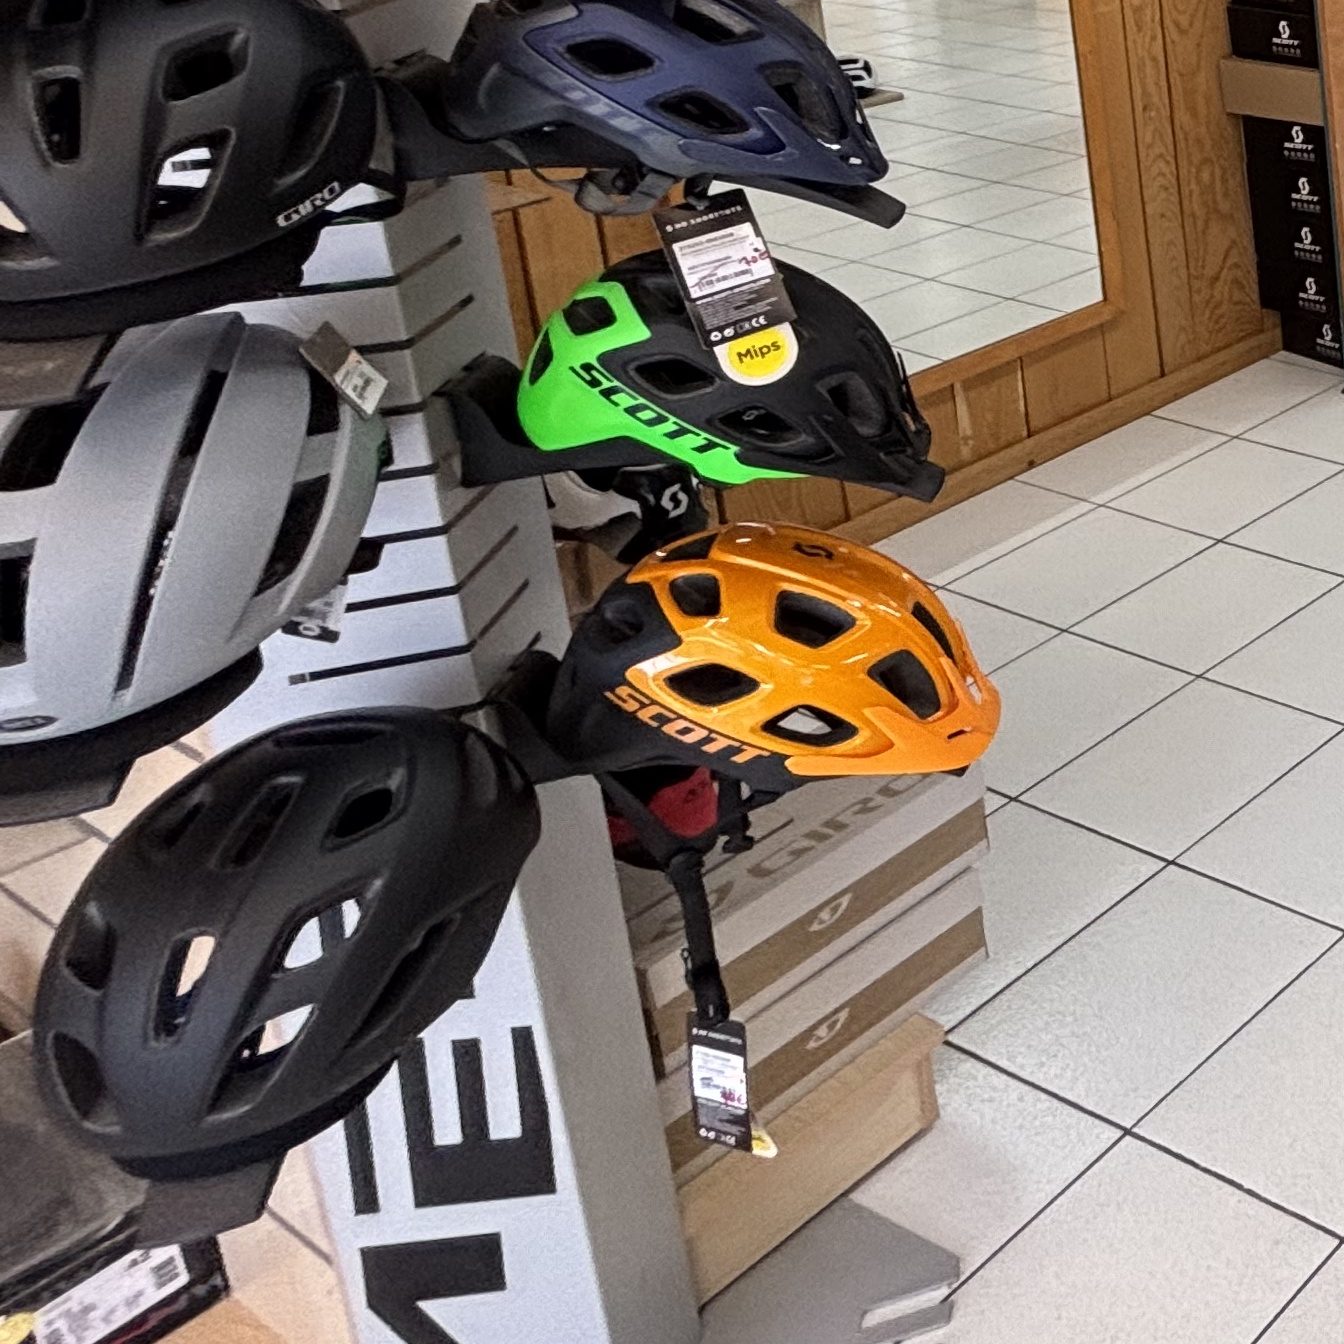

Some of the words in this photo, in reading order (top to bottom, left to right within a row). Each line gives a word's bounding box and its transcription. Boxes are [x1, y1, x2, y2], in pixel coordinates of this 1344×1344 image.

[276, 181, 341, 227] GIRO
[736, 340, 781, 364] Mips
[568, 362, 731, 454] SCOTT
[603, 685, 771, 764] SCOTT
